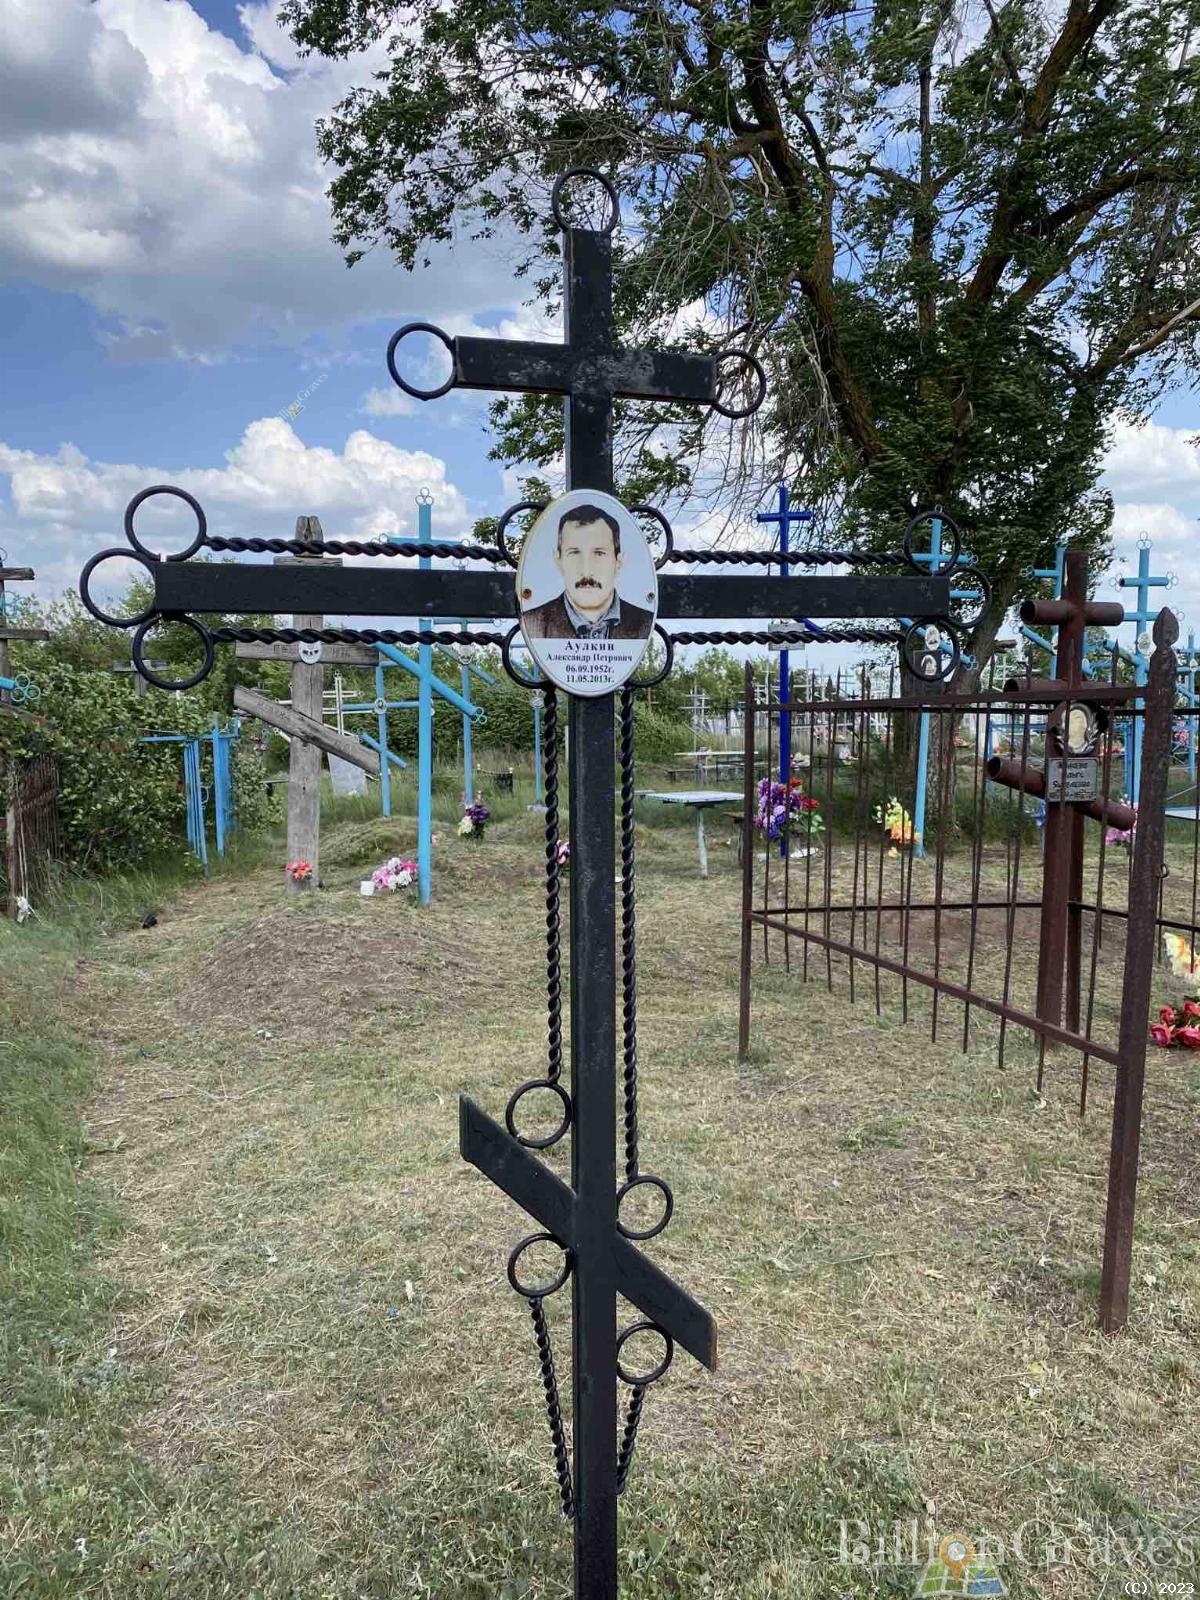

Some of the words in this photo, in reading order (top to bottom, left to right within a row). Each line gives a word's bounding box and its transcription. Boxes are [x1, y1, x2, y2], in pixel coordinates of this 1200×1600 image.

[564, 640, 615, 654] Аулкин
[546, 654, 591, 663] Александр
[593, 654, 633, 663] Петрович
[565, 665, 615, 674] 06.09.1952г.
[566, 675, 615, 684] 11.05.2013г.
